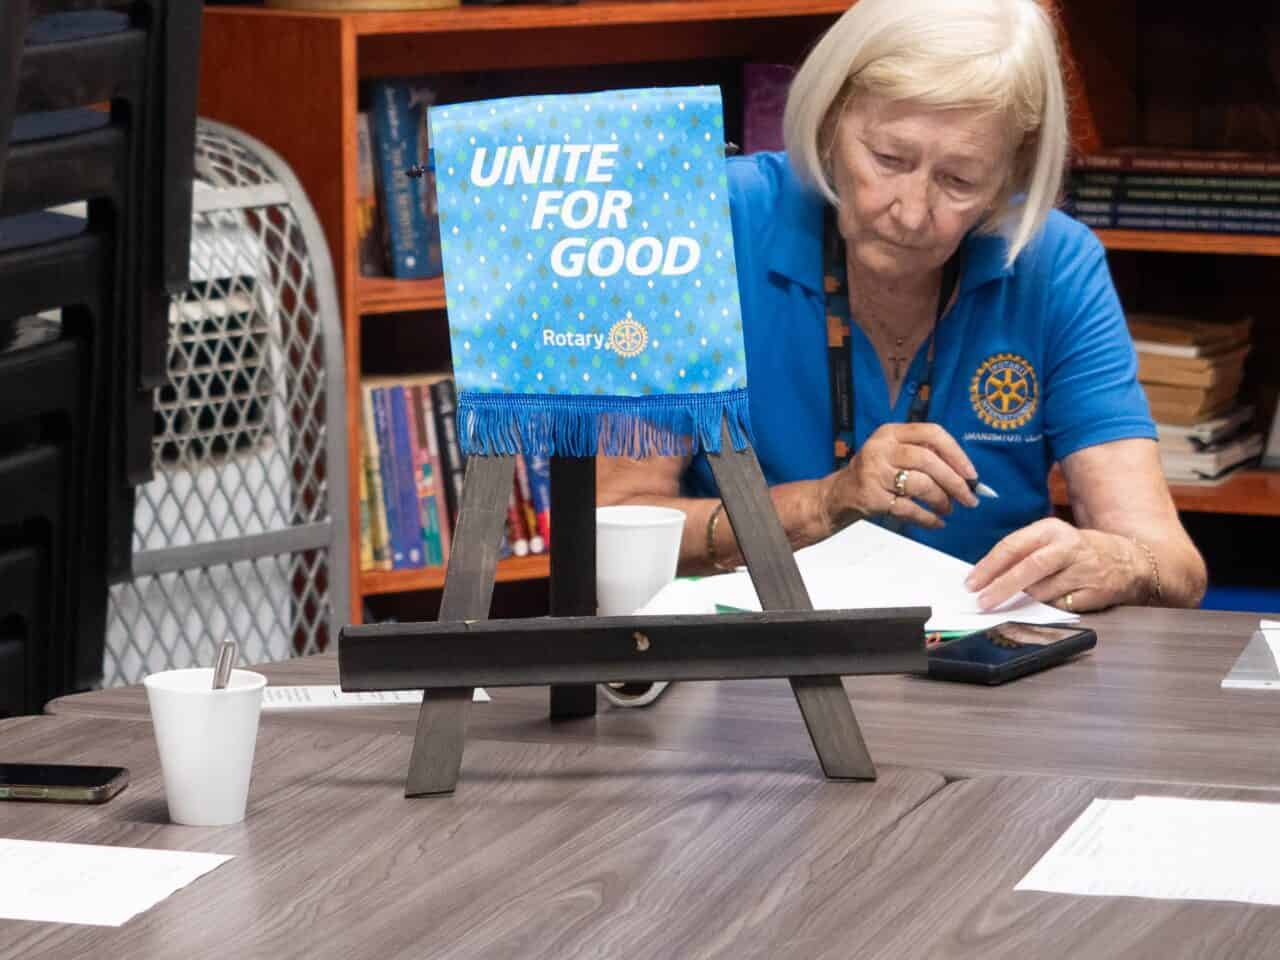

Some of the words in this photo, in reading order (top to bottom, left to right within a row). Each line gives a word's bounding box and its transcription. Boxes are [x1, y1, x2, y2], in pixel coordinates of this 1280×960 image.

[470, 143, 619, 187] UNITE
[530, 190, 633, 231] FOR
[550, 236, 701, 278] GOOD
[542, 329, 605, 350] Rotary
